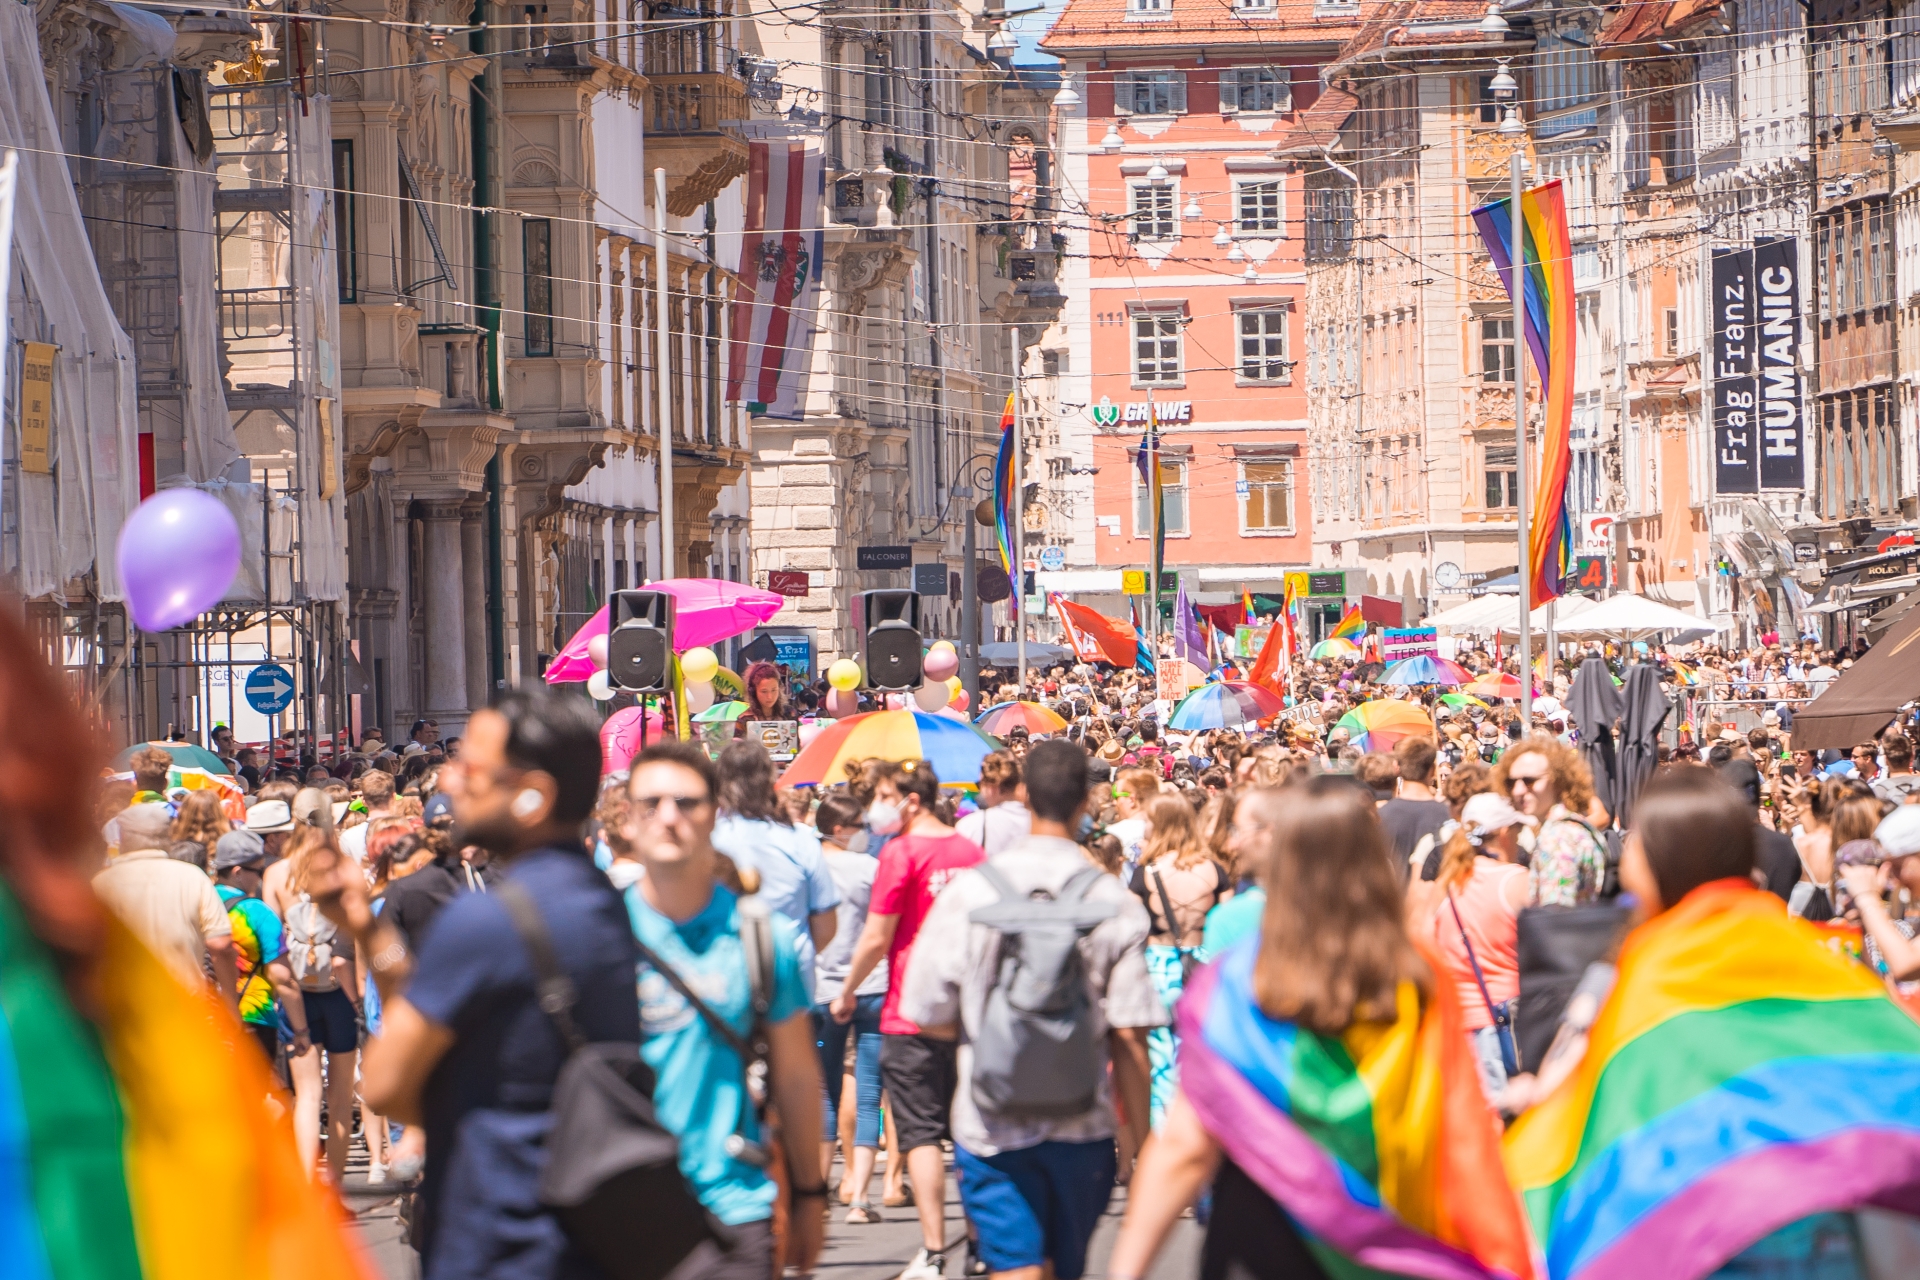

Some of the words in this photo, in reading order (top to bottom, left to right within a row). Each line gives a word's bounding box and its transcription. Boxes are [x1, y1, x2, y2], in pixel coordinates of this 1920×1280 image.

[1096, 311, 1123, 327] 111
[1719, 274, 1746, 379] Franz.
[1761, 265, 1798, 457] HUMANIC
[1722, 390, 1753, 466] Frag
[1868, 566, 1901, 574] ROLEX
[918, 575, 945, 584] COS
[1393, 633, 1430, 644] FUCK
[1391, 647, 1434, 660] TERFS
[1160, 668, 1182, 676] WALL
[1162, 675, 1178, 684] WAS
[1160, 692, 1181, 700] RIOT
[1280, 701, 1321, 721] PRIDE
